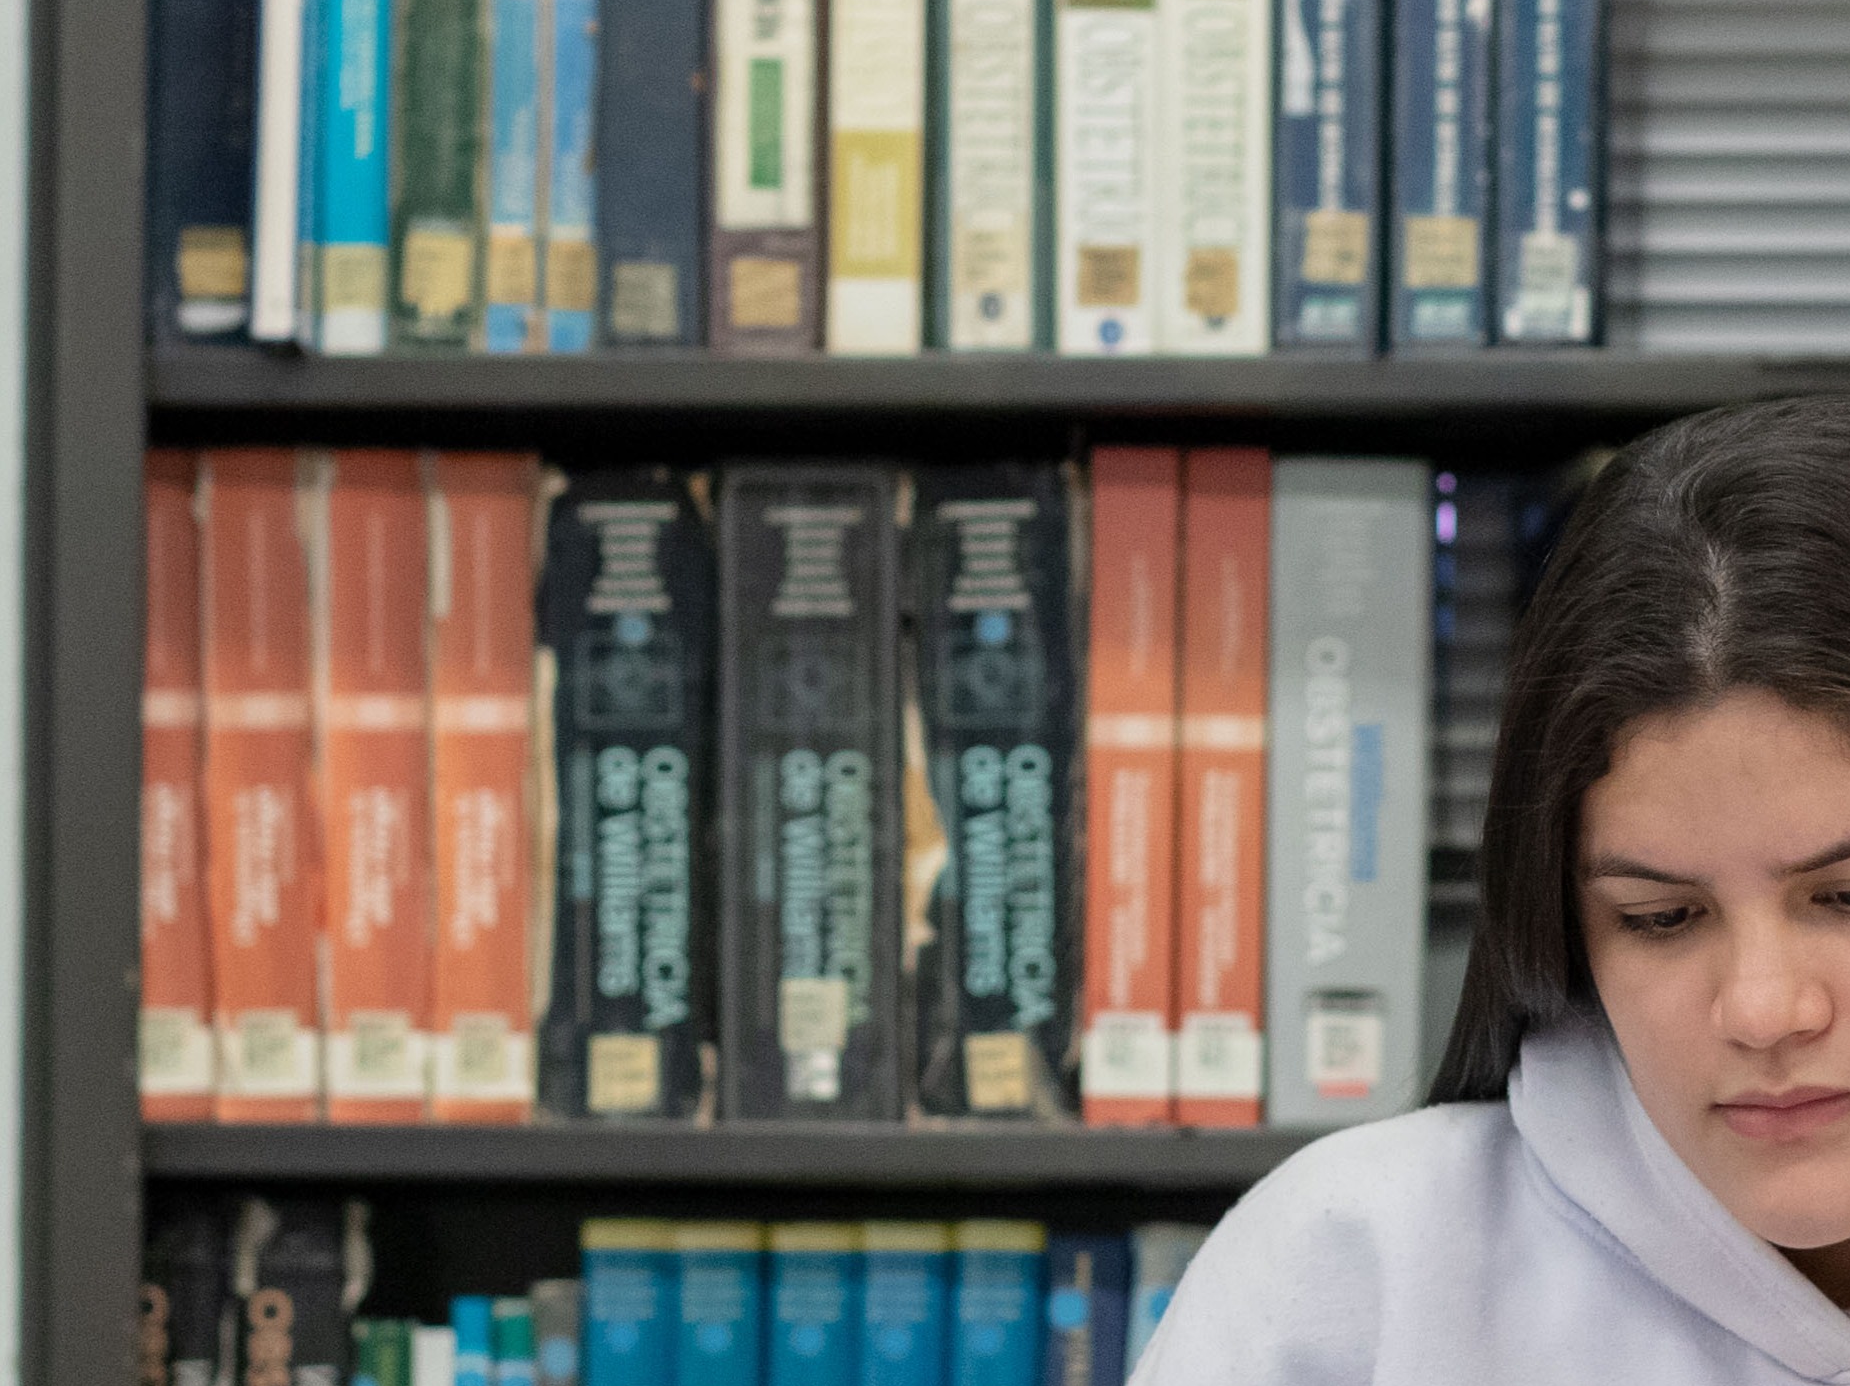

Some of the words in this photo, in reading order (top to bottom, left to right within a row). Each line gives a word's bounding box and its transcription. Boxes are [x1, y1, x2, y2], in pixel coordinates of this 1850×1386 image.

[961, 1, 1023, 229] OBSTETRIC
[1079, 20, 1144, 245] OBSTETRI
[597, 745, 640, 810] de
[960, 744, 1004, 809] de
[1306, 635, 1350, 965] OBSTETRICIA
[599, 815, 639, 996] Williams
[639, 745, 689, 1029] OBSTETRICIA
[780, 817, 824, 977] William
[963, 811, 1005, 998] Williams
[1005, 744, 1055, 1028] OBSTETRICIA
